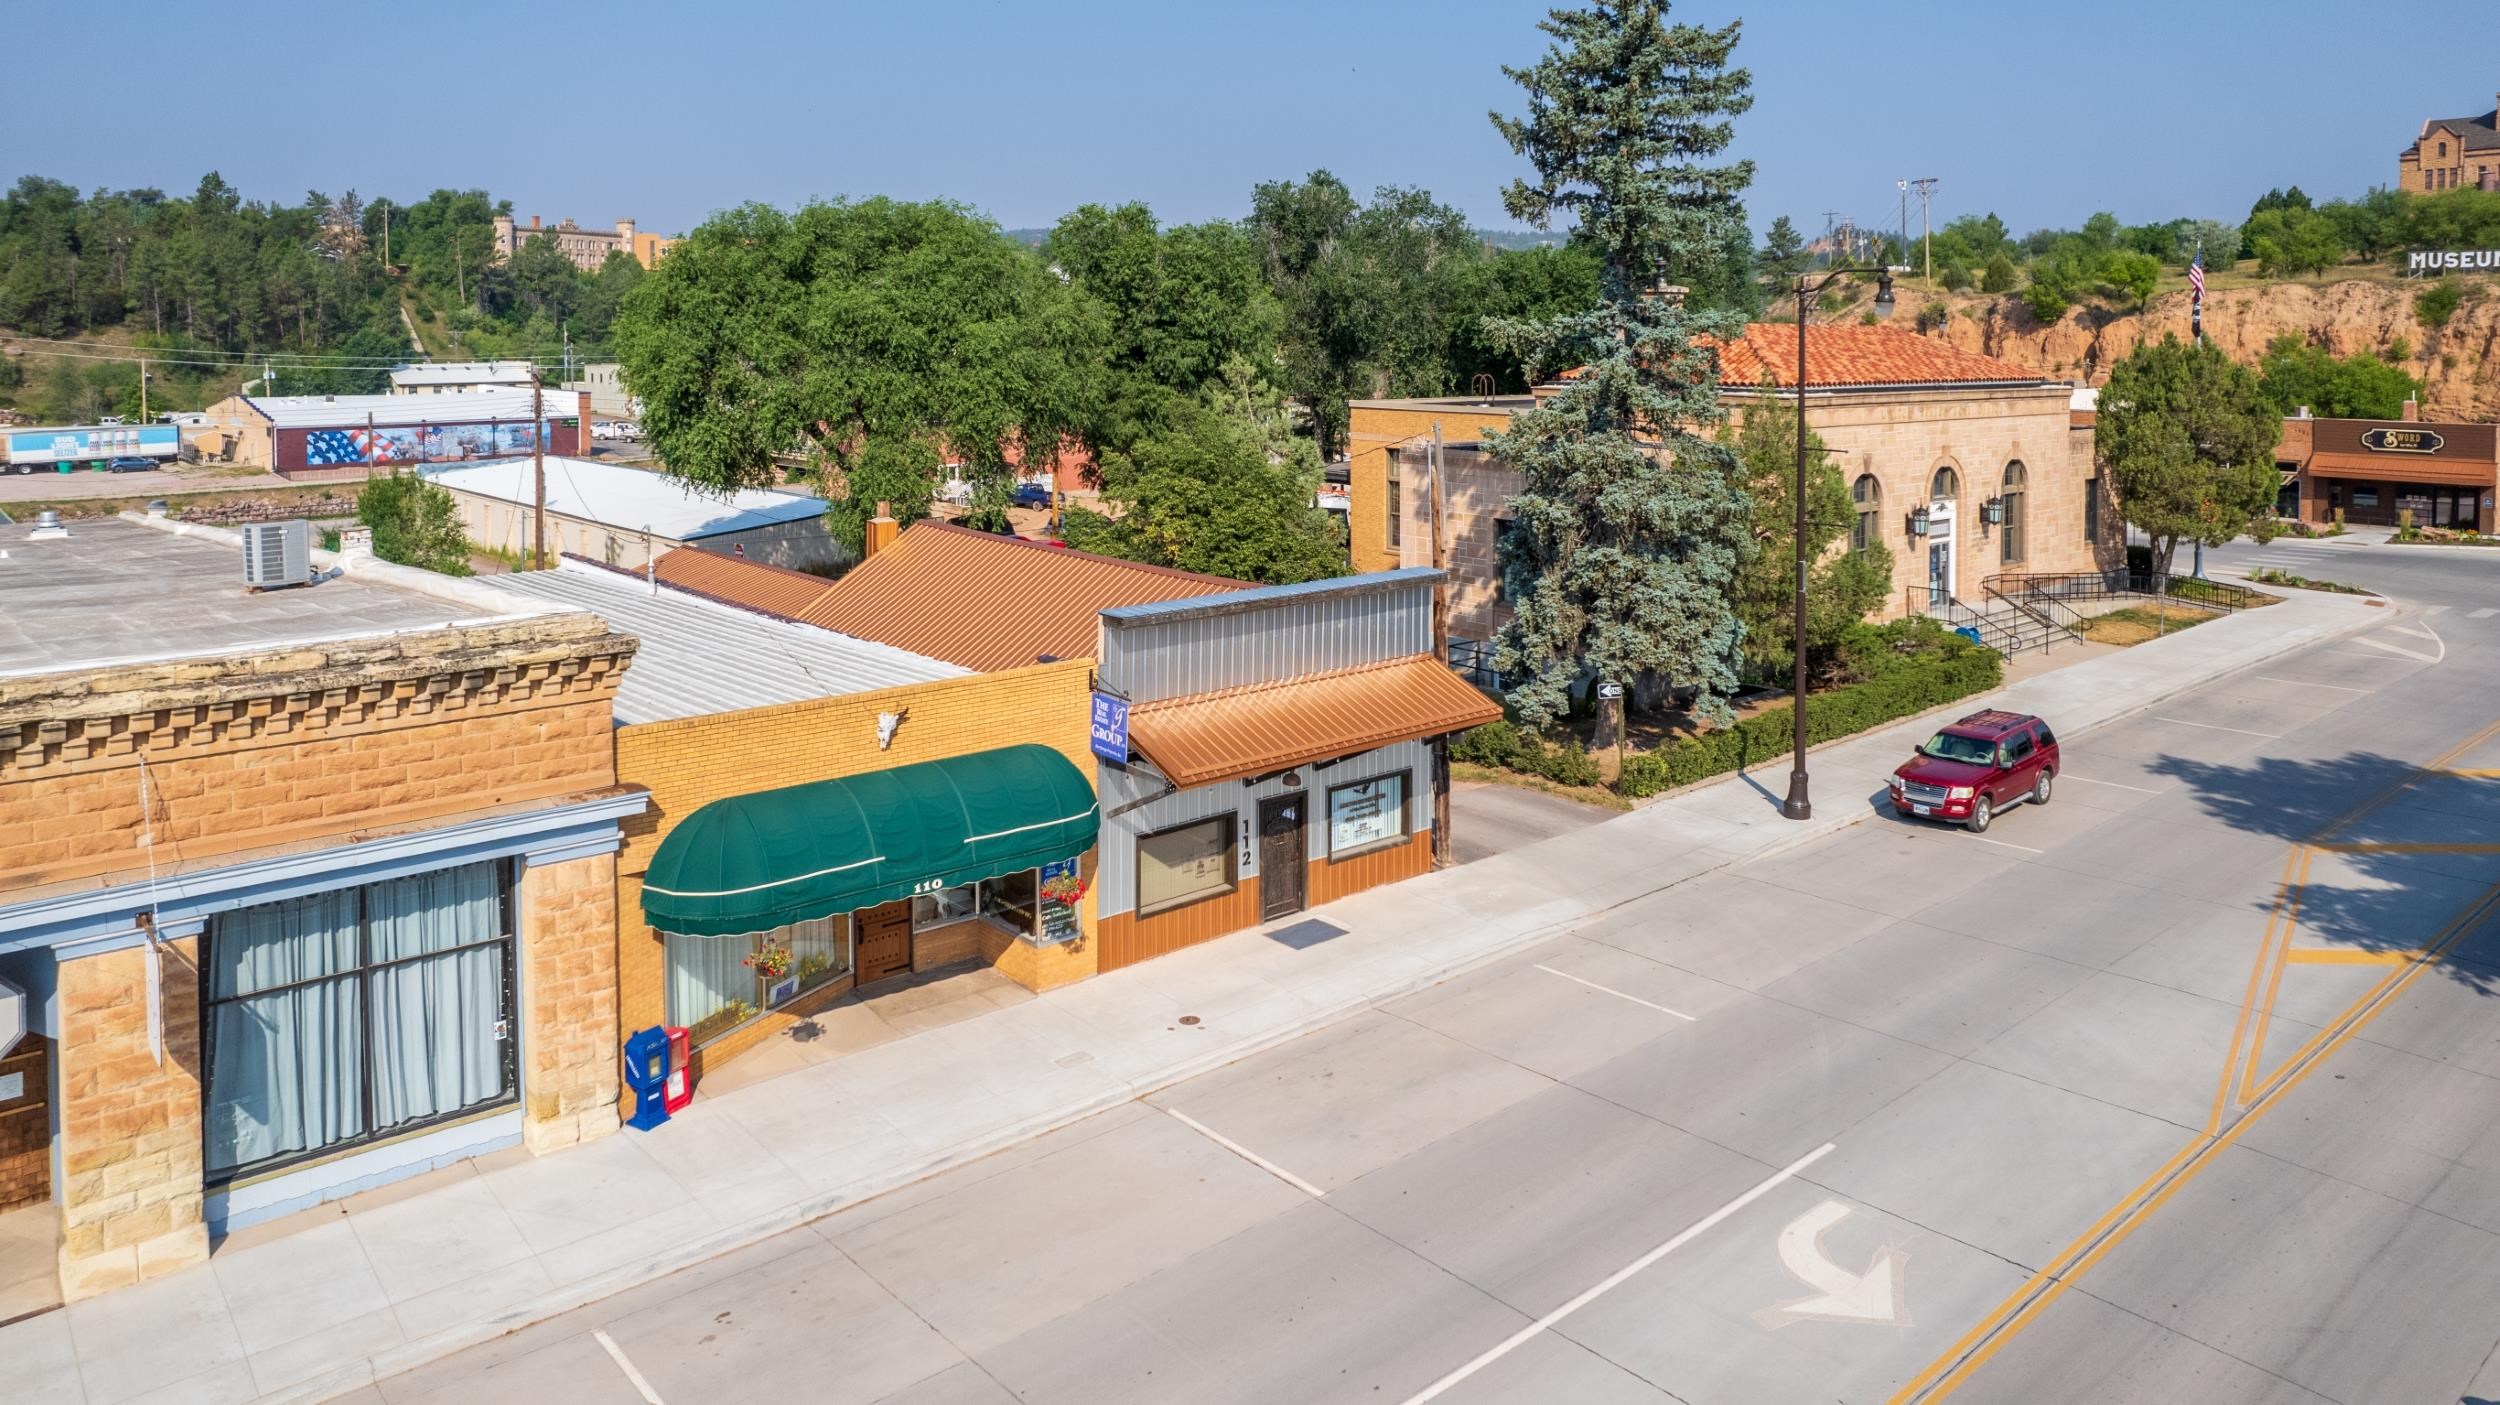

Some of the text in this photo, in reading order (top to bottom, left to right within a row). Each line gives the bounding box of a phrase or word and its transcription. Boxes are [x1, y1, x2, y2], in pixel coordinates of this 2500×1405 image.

[1095, 698, 1109, 712] THE
[1092, 724, 1123, 746] GROUP
[1242, 819, 1251, 866] 112
[914, 878, 943, 894] 110
